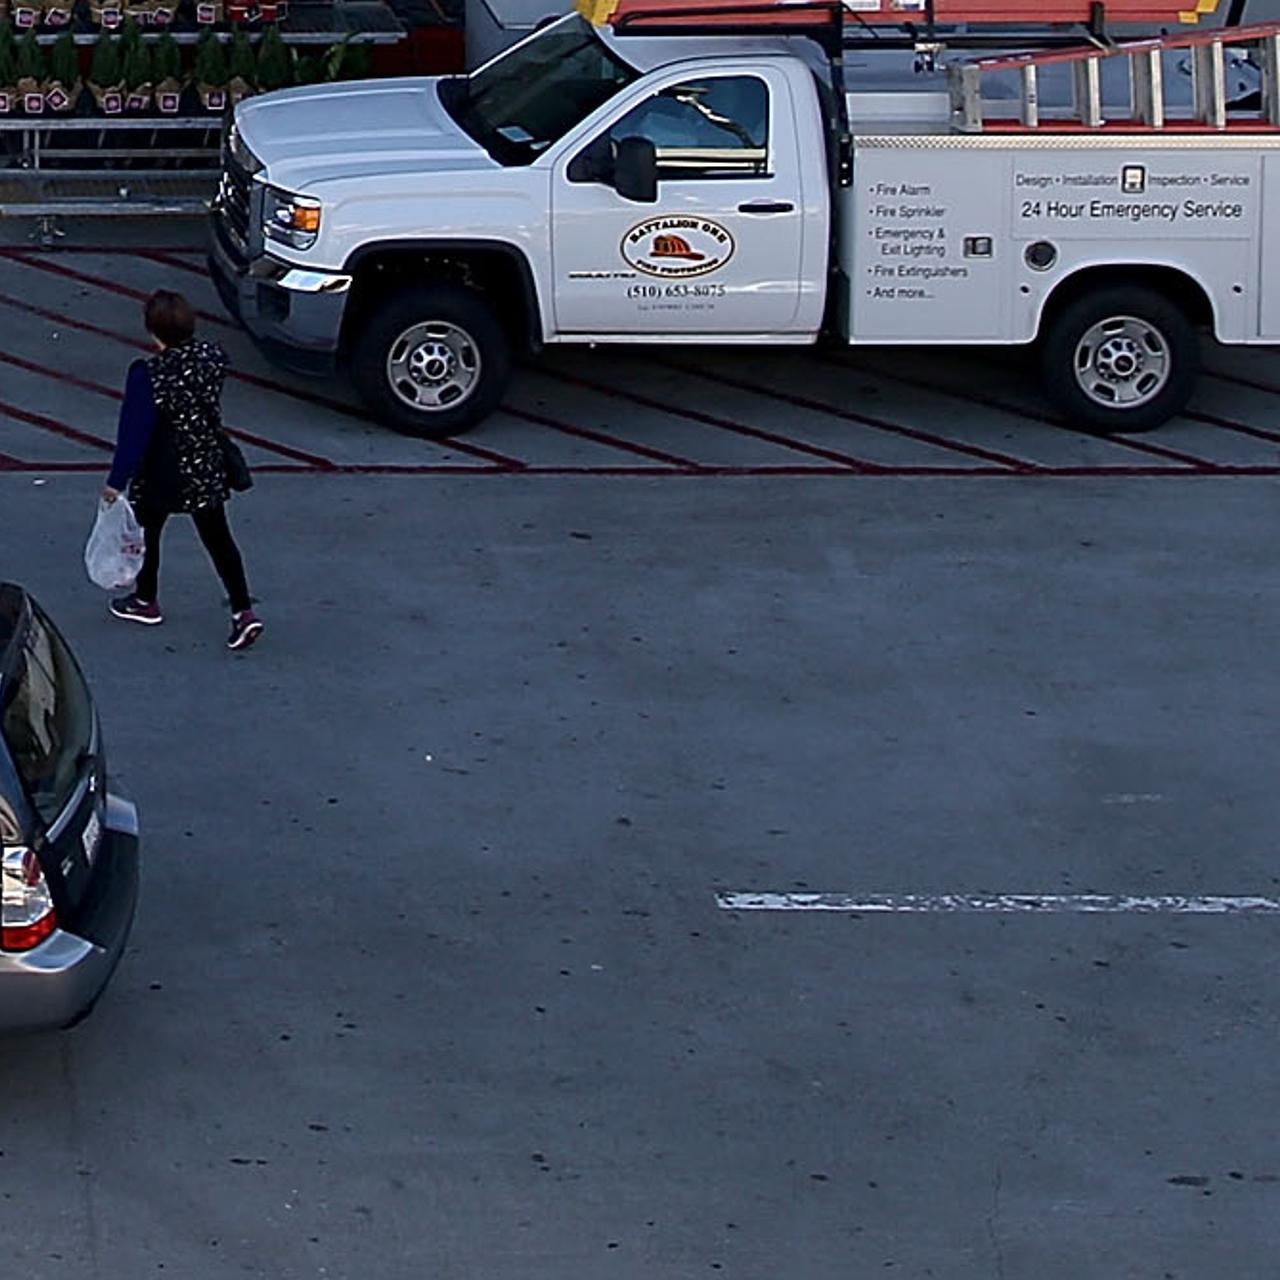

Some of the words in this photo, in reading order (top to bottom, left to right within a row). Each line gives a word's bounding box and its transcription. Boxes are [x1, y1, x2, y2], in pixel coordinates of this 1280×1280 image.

[1015, 174, 1053, 188] Design
[1062, 173, 1118, 186] Installation
[1148, 173, 1201, 188] Inspection
[1210, 174, 1250, 186] Service
[876, 184, 897, 195] Fire
[900, 184, 931, 195] Alarm
[875, 205, 896, 217] Fire
[899, 205, 946, 219] Sprinkler
[1021, 201, 1041, 218] 24
[1046, 200, 1085, 218] Hour
[1089, 200, 1178, 222] Emergency
[1183, 200, 1243, 218] Service
[629, 219, 700, 243] BATTALION
[701, 223, 728, 243] ONE
[875, 227, 936, 241] Emergency
[881, 243, 901, 255] Exit
[903, 244, 946, 258] Lighting
[636, 258, 658, 272] FIRE
[660, 257, 720, 274] PROTECTION
[873, 265, 895, 277] Fire
[897, 265, 968, 279] Extinguishers
[627, 285, 662, 299] (510)
[665, 284, 726, 298] 653-8075
[873, 287, 895, 299] And
